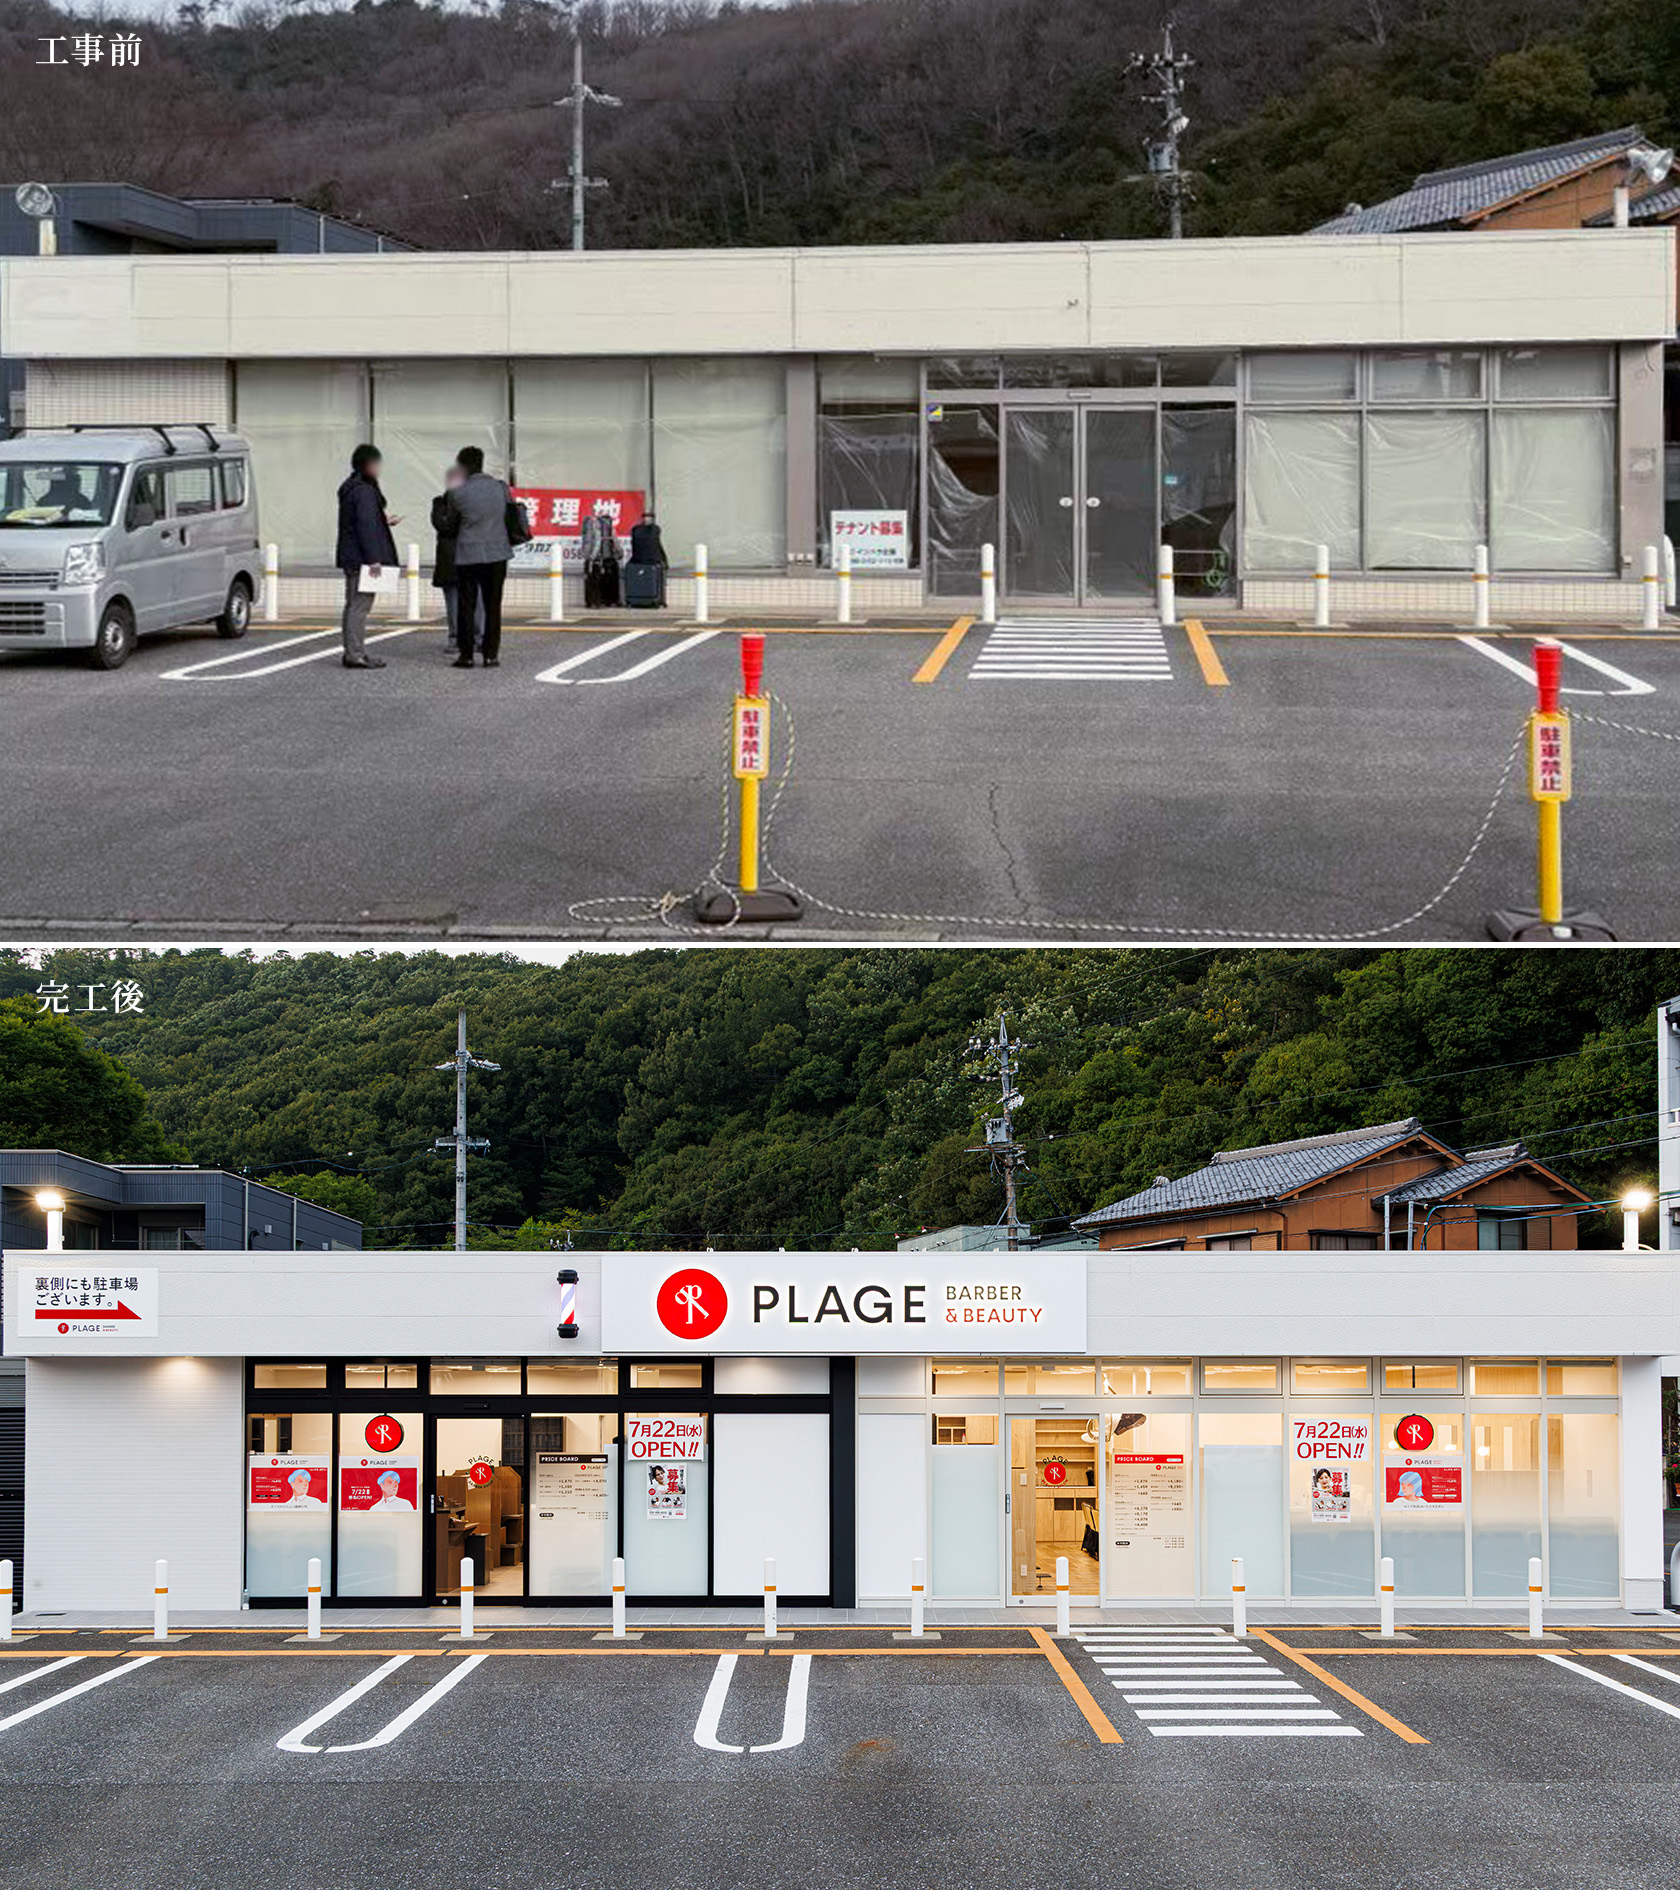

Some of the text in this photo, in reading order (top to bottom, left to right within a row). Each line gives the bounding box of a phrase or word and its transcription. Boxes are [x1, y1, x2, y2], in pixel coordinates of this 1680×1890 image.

[835, 520, 904, 536] テナント募集
[1540, 726, 1562, 792] 駐車禁止
[35, 1276, 139, 1291] 裏側にも駐車場
[36, 1292, 113, 1308] ございます。
[946, 1286, 1022, 1300] BARBER
[753, 1284, 926, 1323] PLAGE
[945, 1308, 1043, 1323] & BEAUTY
[72, 1324, 101, 1332] PLAGE
[629, 1420, 703, 1438] 7月22日(水)
[1294, 1421, 1368, 1439] 7月22日(水)
[631, 1441, 700, 1458] OPEN!!
[1297, 1442, 1365, 1459] OPEN!!
[468, 1455, 495, 1466] PLAGE
[1042, 1455, 1069, 1466] PLAGE
[667, 1468, 679, 1493] 募集
[1331, 1471, 1343, 1496] 募集
